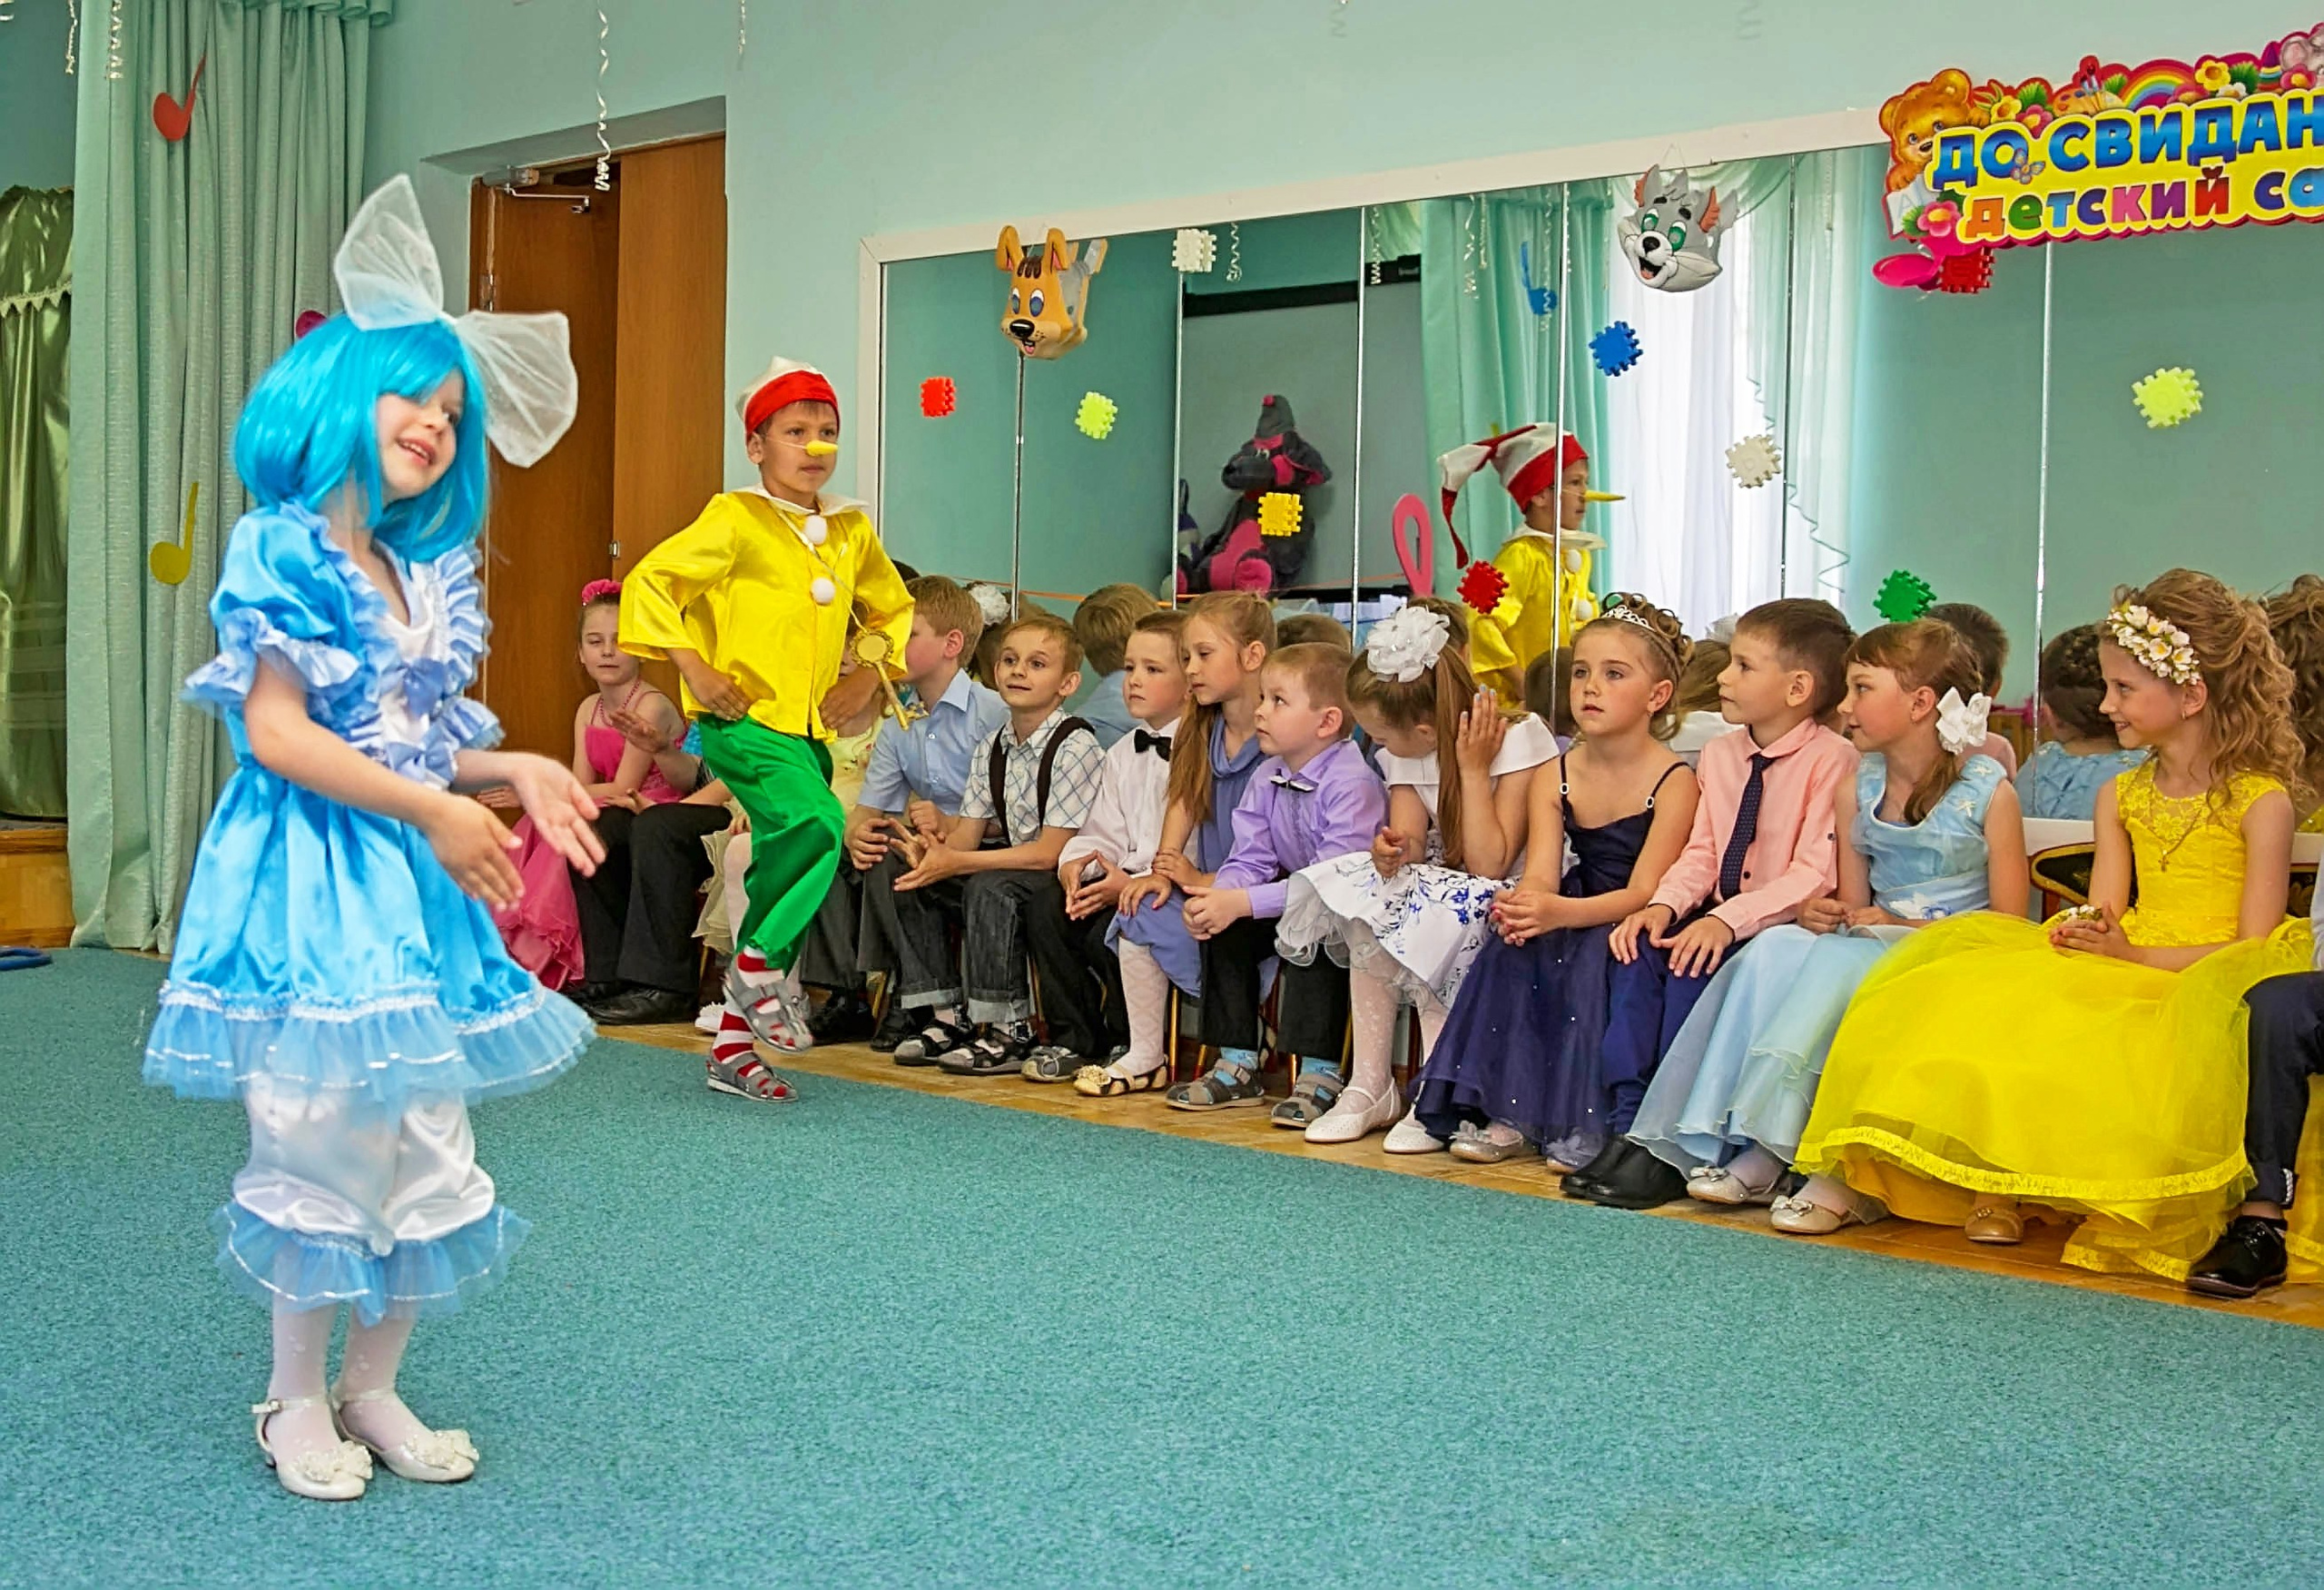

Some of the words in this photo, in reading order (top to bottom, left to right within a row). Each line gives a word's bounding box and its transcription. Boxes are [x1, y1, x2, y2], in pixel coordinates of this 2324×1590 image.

[1931, 129, 2030, 190] ДО
[2048, 94, 2324, 173] СВИДАН
[1965, 166, 2230, 239] детский
